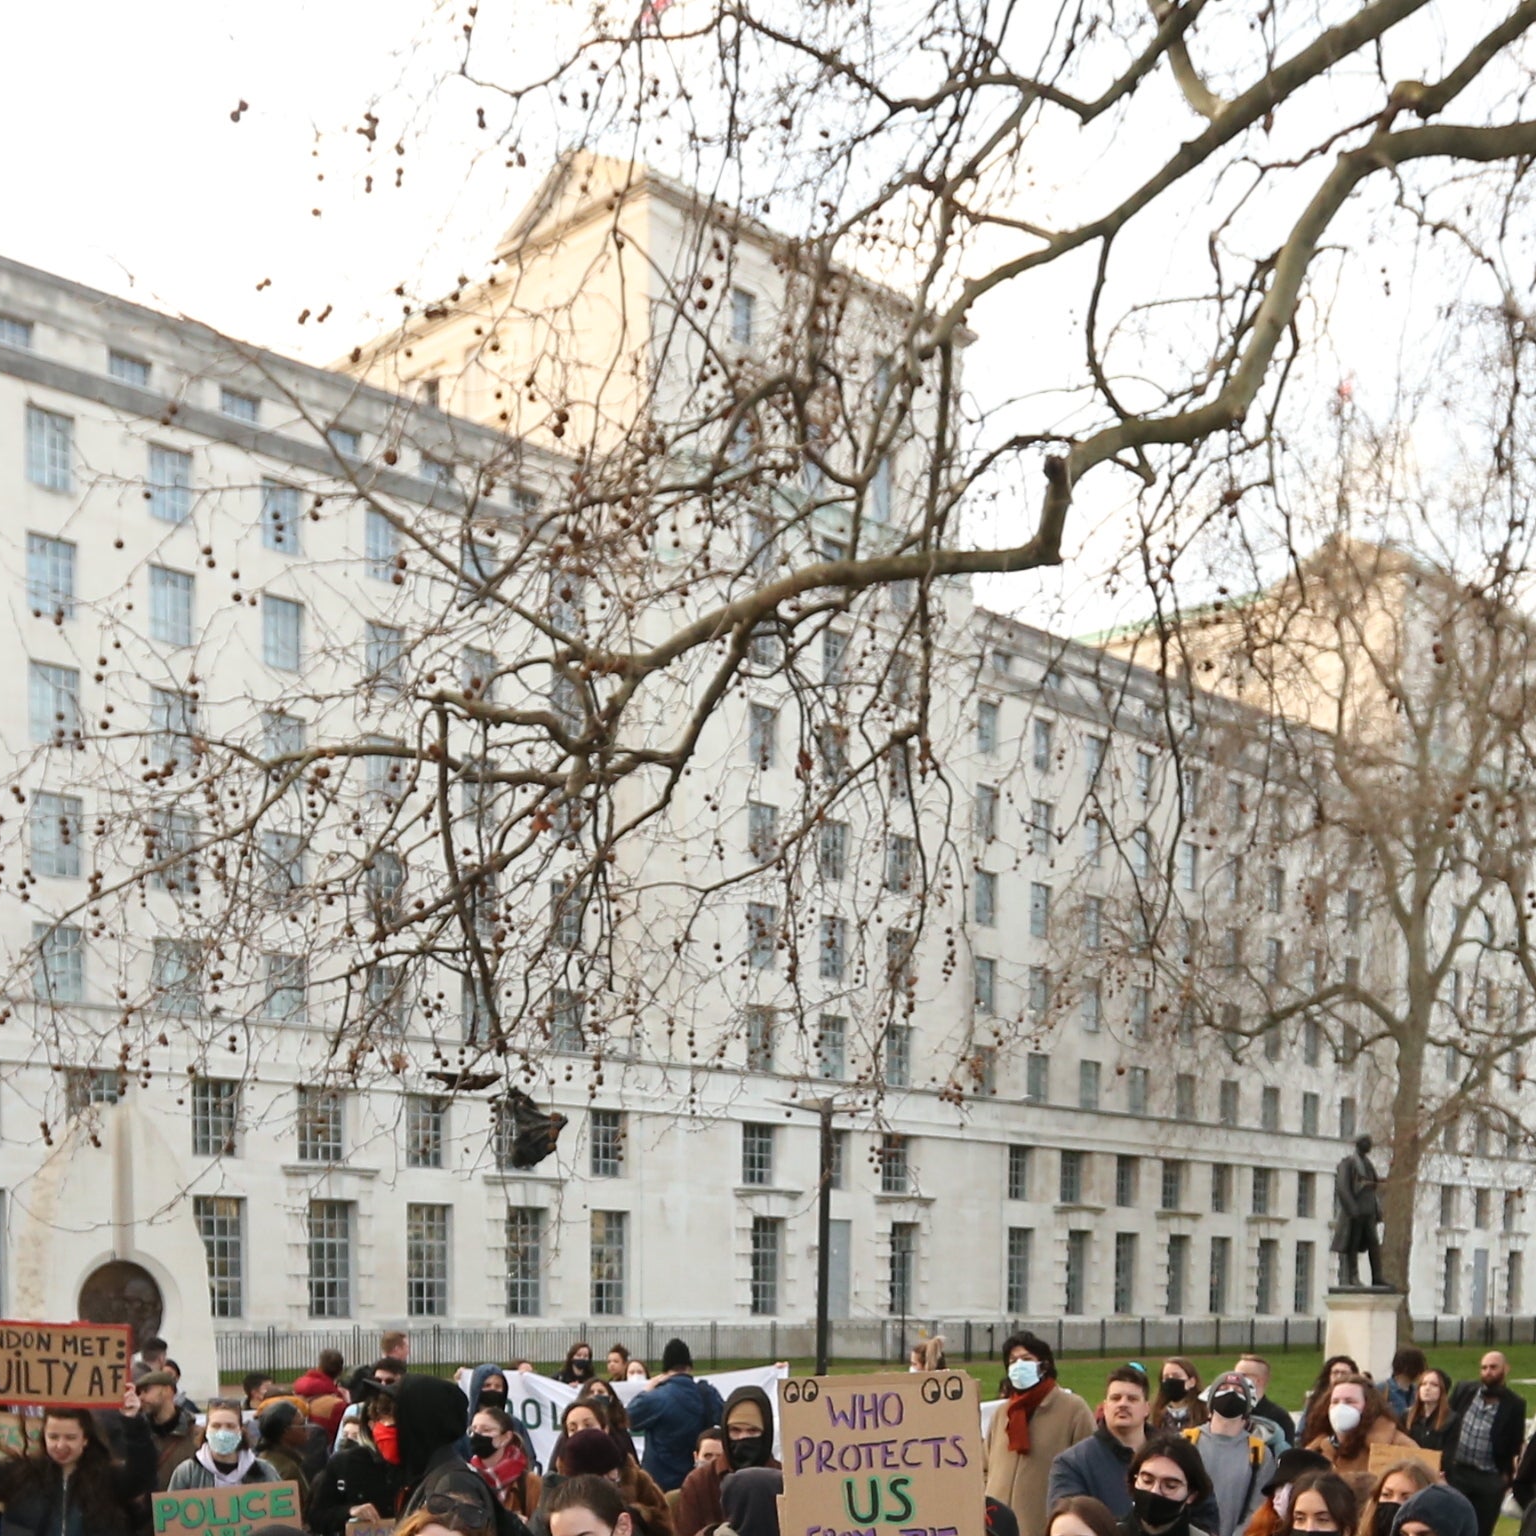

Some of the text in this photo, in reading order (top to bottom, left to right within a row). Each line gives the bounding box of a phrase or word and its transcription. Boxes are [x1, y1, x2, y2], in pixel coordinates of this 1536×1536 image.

[88, 1364, 125, 1396] AF
[825, 1392, 904, 1430] WHO
[794, 1435, 968, 1477] PROTECTS
[154, 1488, 296, 1533] POLICE
[844, 1477, 914, 1525] US
